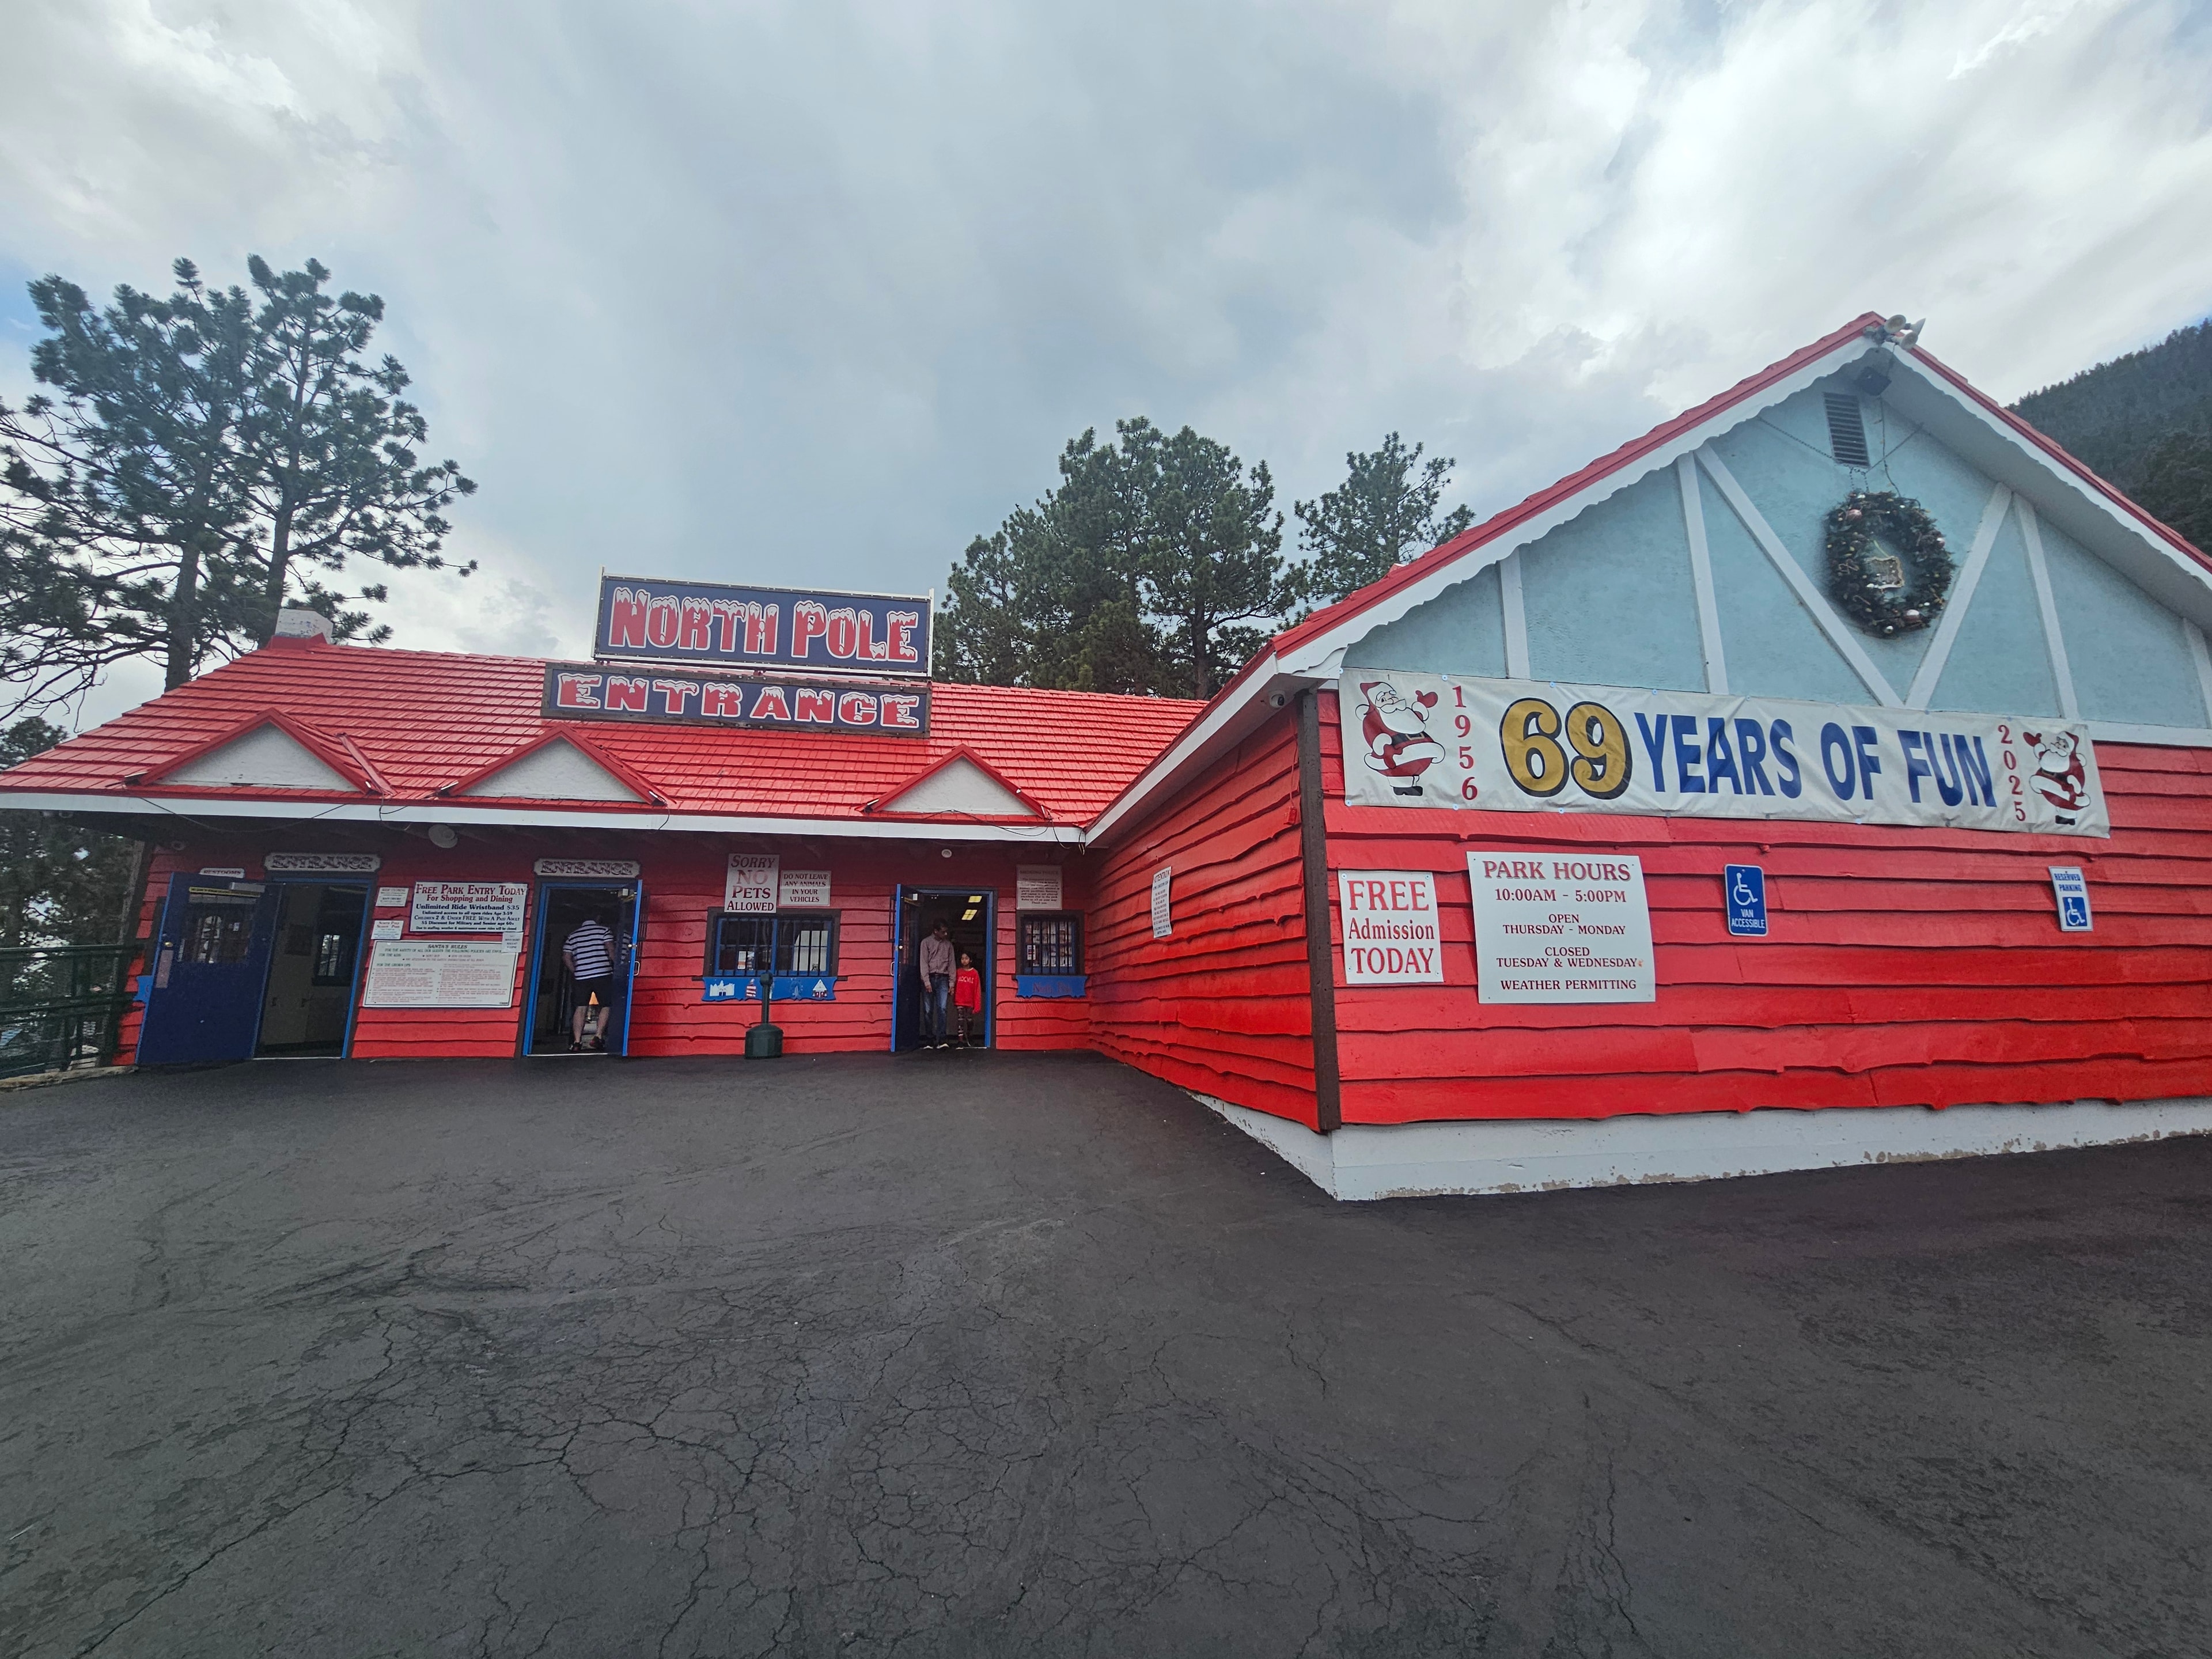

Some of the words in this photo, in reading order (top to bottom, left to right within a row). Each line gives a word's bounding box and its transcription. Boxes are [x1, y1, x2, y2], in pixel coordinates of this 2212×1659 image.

[608, 586, 779, 654] NORTH
[791, 600, 918, 662] POLE
[556, 672, 920, 728] ENTRANCE
[1499, 698, 1633, 800] 69
[1634, 712, 1802, 799] YEARS
[1820, 722, 1881, 801] OF
[1897, 729, 1997, 808] FUN
[271, 855, 373, 869] ENTRANCE
[540, 861, 633, 875] ENTRANCE
[731, 855, 775, 868] SORRY
[736, 869, 768, 885] NO
[1482, 861, 1546, 880] PARK
[1552, 862, 1631, 881] HOURS
[415, 884, 438, 894] FREE
[441, 884, 464, 895] PARK
[467, 885, 495, 895] ENTRY
[499, 885, 525, 896] TODAY
[732, 885, 771, 899] PETS
[1347, 880, 1429, 911] FREE
[1495, 888, 1556, 901] 10:00AM
[1575, 890, 1627, 902] 5:00PM
[441, 895, 473, 903] Shopping
[726, 900, 774, 911] ALLOWED
[1548, 914, 1580, 923] OPEN
[1740, 909, 1754, 918] VAN
[1349, 917, 1434, 940] Admission
[1502, 925, 1564, 934] THURSDAY
[1578, 925, 1626, 934] MONDAY
[1731, 918, 1766, 929] ACCESSIBLE
[1544, 947, 1590, 956] CLOSED
[1351, 947, 1434, 974] TODAY
[1497, 958, 1549, 967] TUESDAY
[1554, 958, 1563, 967] &
[1567, 958, 1637, 967] WEDNESDAY
[1501, 980, 1560, 990] WEATHER
[1565, 980, 1637, 989] PERMITTING
